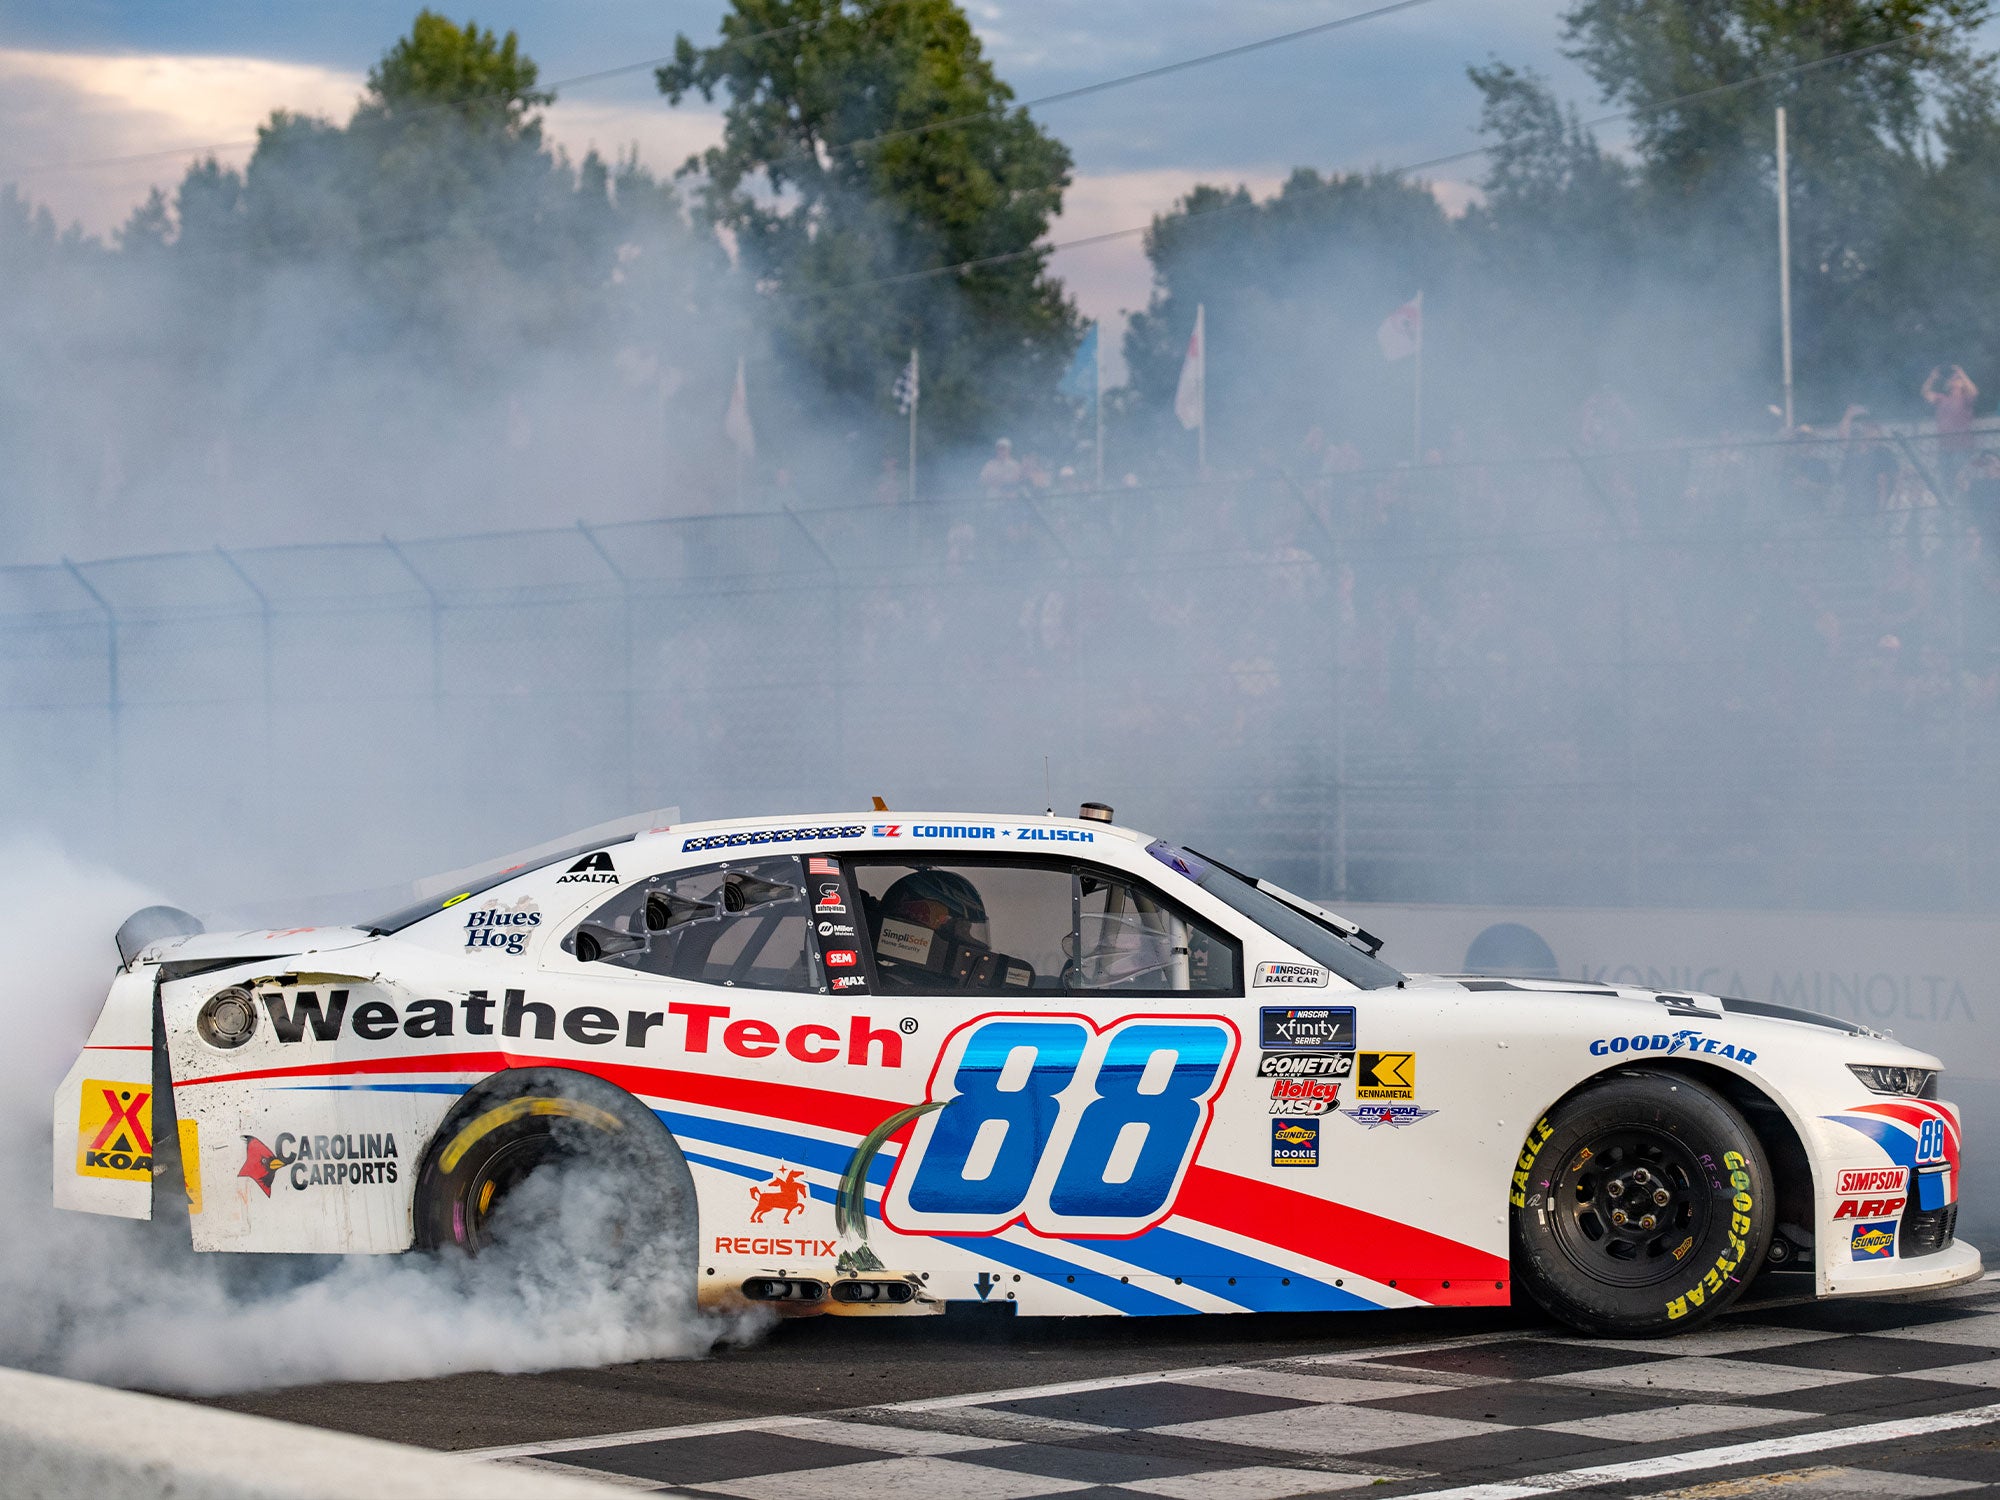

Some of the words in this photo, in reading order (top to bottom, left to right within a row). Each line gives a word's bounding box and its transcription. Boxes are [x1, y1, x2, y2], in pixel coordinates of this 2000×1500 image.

[913, 826, 995, 838] CONNOR
[1017, 828, 1094, 842] ZILISCH
[556, 873, 620, 884] AXALTA
[465, 909, 542, 929] Blues
[464, 928, 527, 954] Hog
[882, 928, 929, 948] SimpliSafe
[830, 953, 853, 964] SEM
[1279, 966, 1320, 976] NASCAR
[1297, 976, 1318, 984] CAR
[1276, 1019, 1340, 1041] xfinity
[1294, 1037, 1321, 1045] SERIES
[1590, 1035, 1758, 1066] GOODYEAR
[1261, 1056, 1352, 1074] COMETIC
[1271, 1079, 1341, 1102] Holley
[1358, 1090, 1412, 1098] KENNAMETAL
[1269, 1100, 1331, 1115] MSD
[1358, 1107, 1388, 1116] FIVE
[1390, 1107, 1419, 1116] STAR
[908, 1022, 1229, 1218] 88
[1277, 1131, 1315, 1139] SUNOCO
[1918, 1120, 1944, 1160] 88
[274, 1132, 398, 1163] CAROLINA
[1274, 1150, 1317, 1158] ROOKIE
[86, 1150, 152, 1172] KOA
[1510, 1117, 1554, 1208] EAGLE
[290, 1160, 398, 1191] CARPORTS
[1841, 1171, 1903, 1191] SIMPSON
[1833, 1197, 1905, 1218] ARP
[715, 1236, 837, 1257] REGISTIX
[1853, 1235, 1893, 1248] SUNOCO
